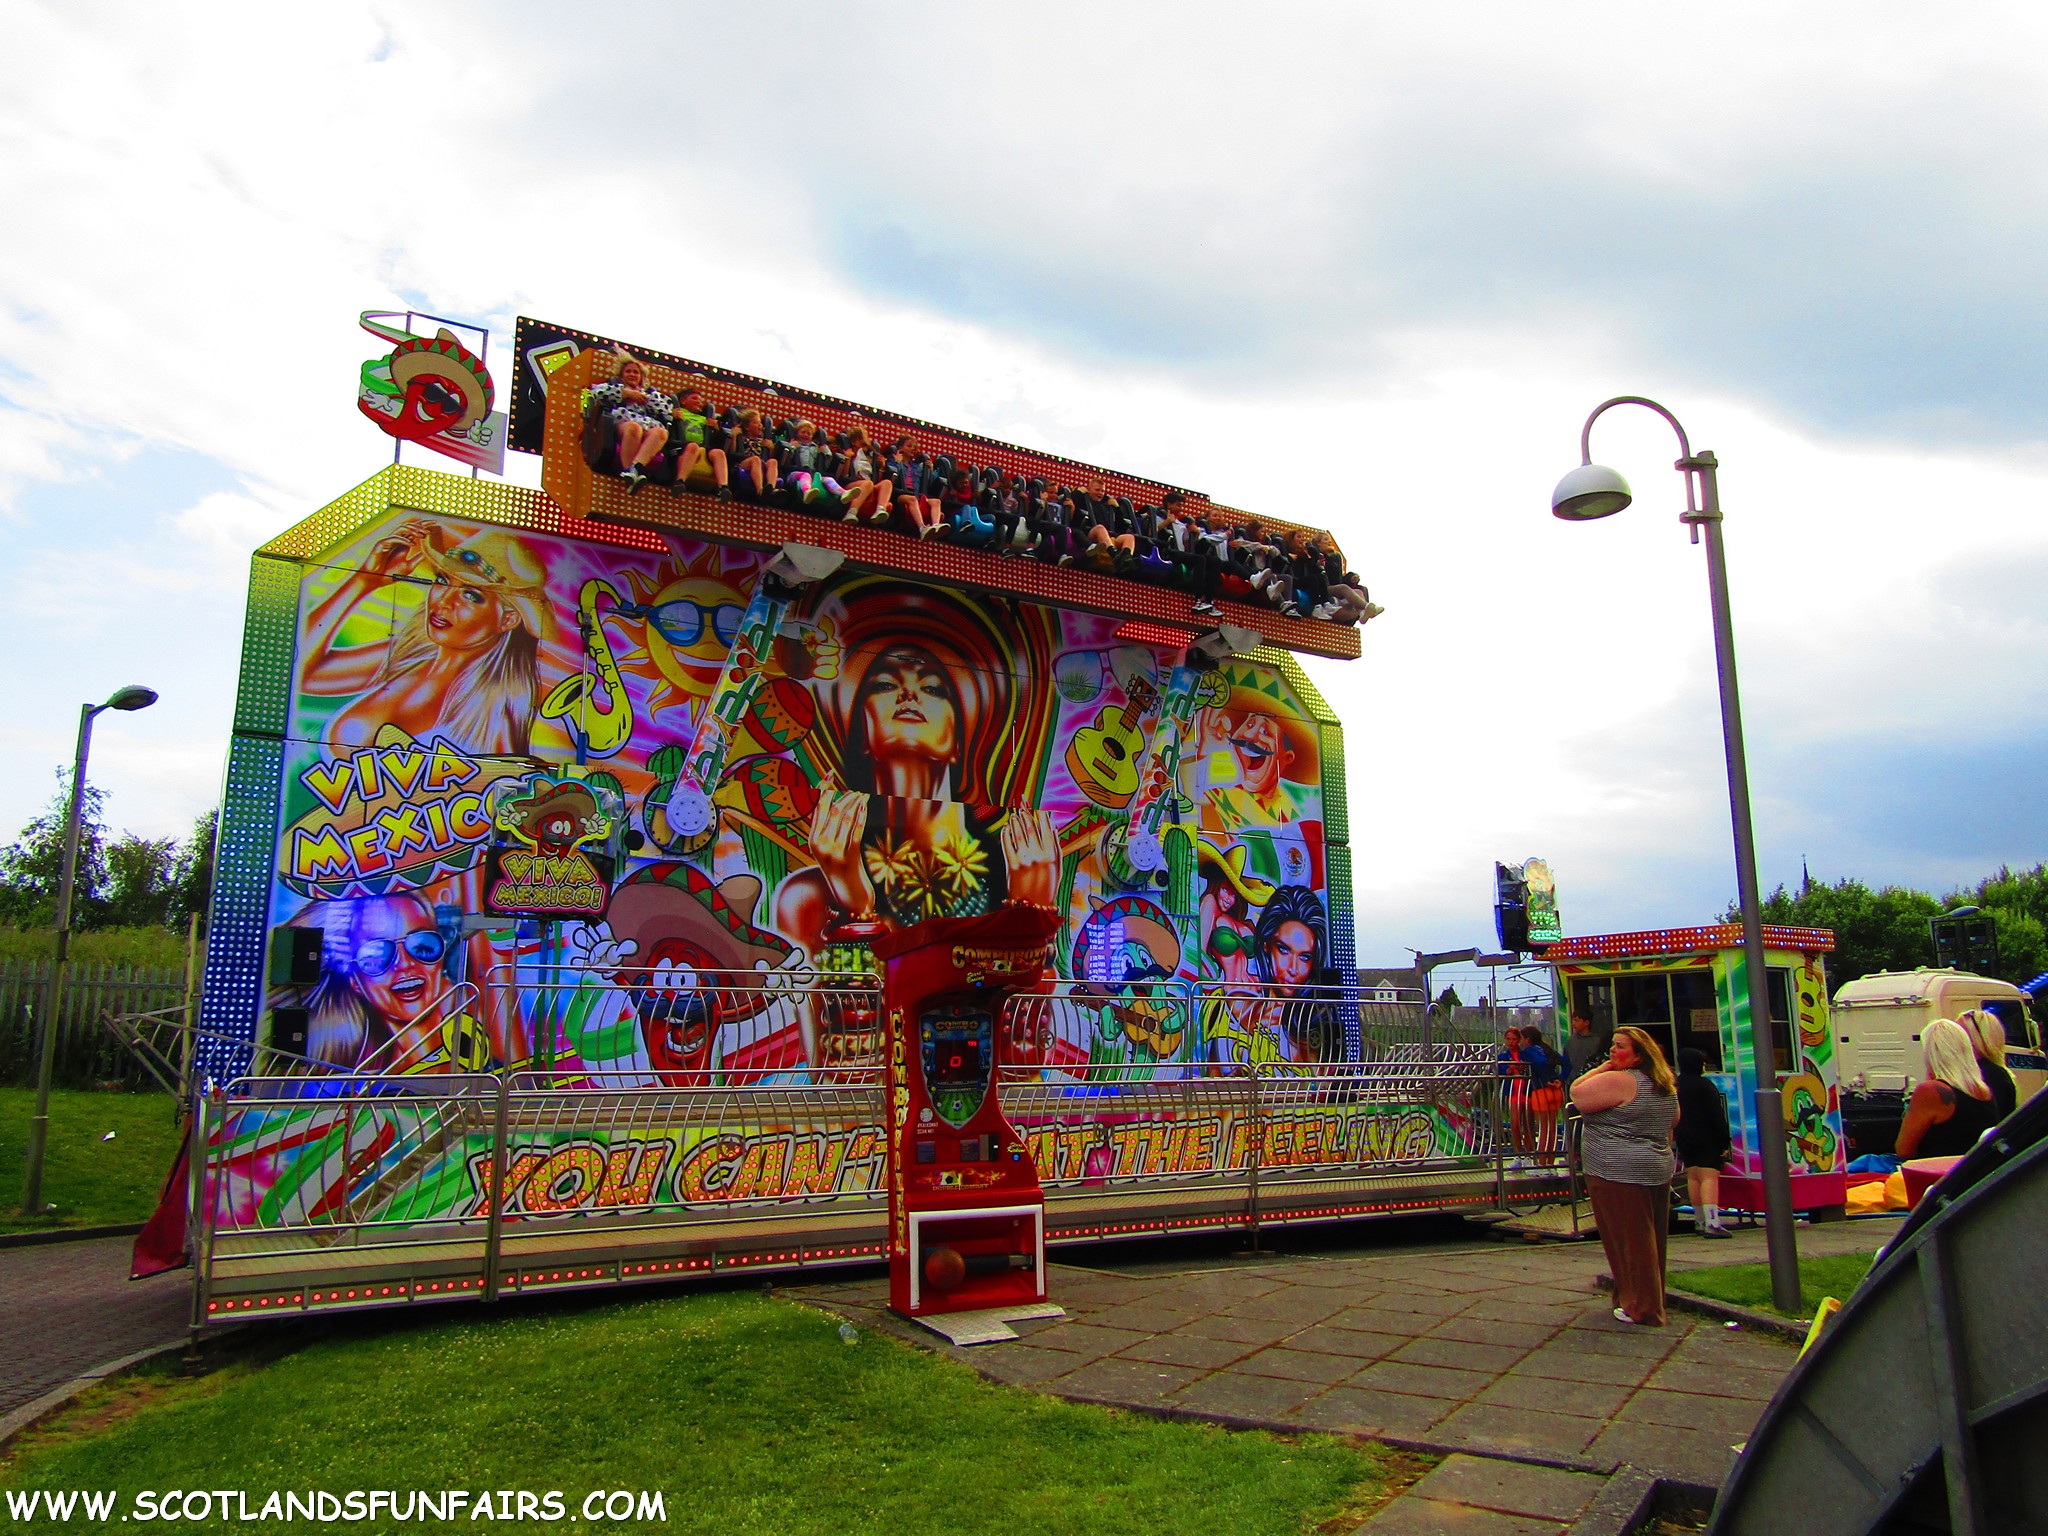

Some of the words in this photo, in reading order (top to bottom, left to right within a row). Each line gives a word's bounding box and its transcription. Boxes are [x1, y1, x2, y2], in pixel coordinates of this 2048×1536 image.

[301, 736, 480, 814] VIVA
[494, 884, 603, 909] MEXICO!
[504, 854, 597, 886] VIVA
[461, 1137, 676, 1224] YOU
[1108, 1116, 1222, 1184] THE
[1222, 1110, 1436, 1177] FEELING
